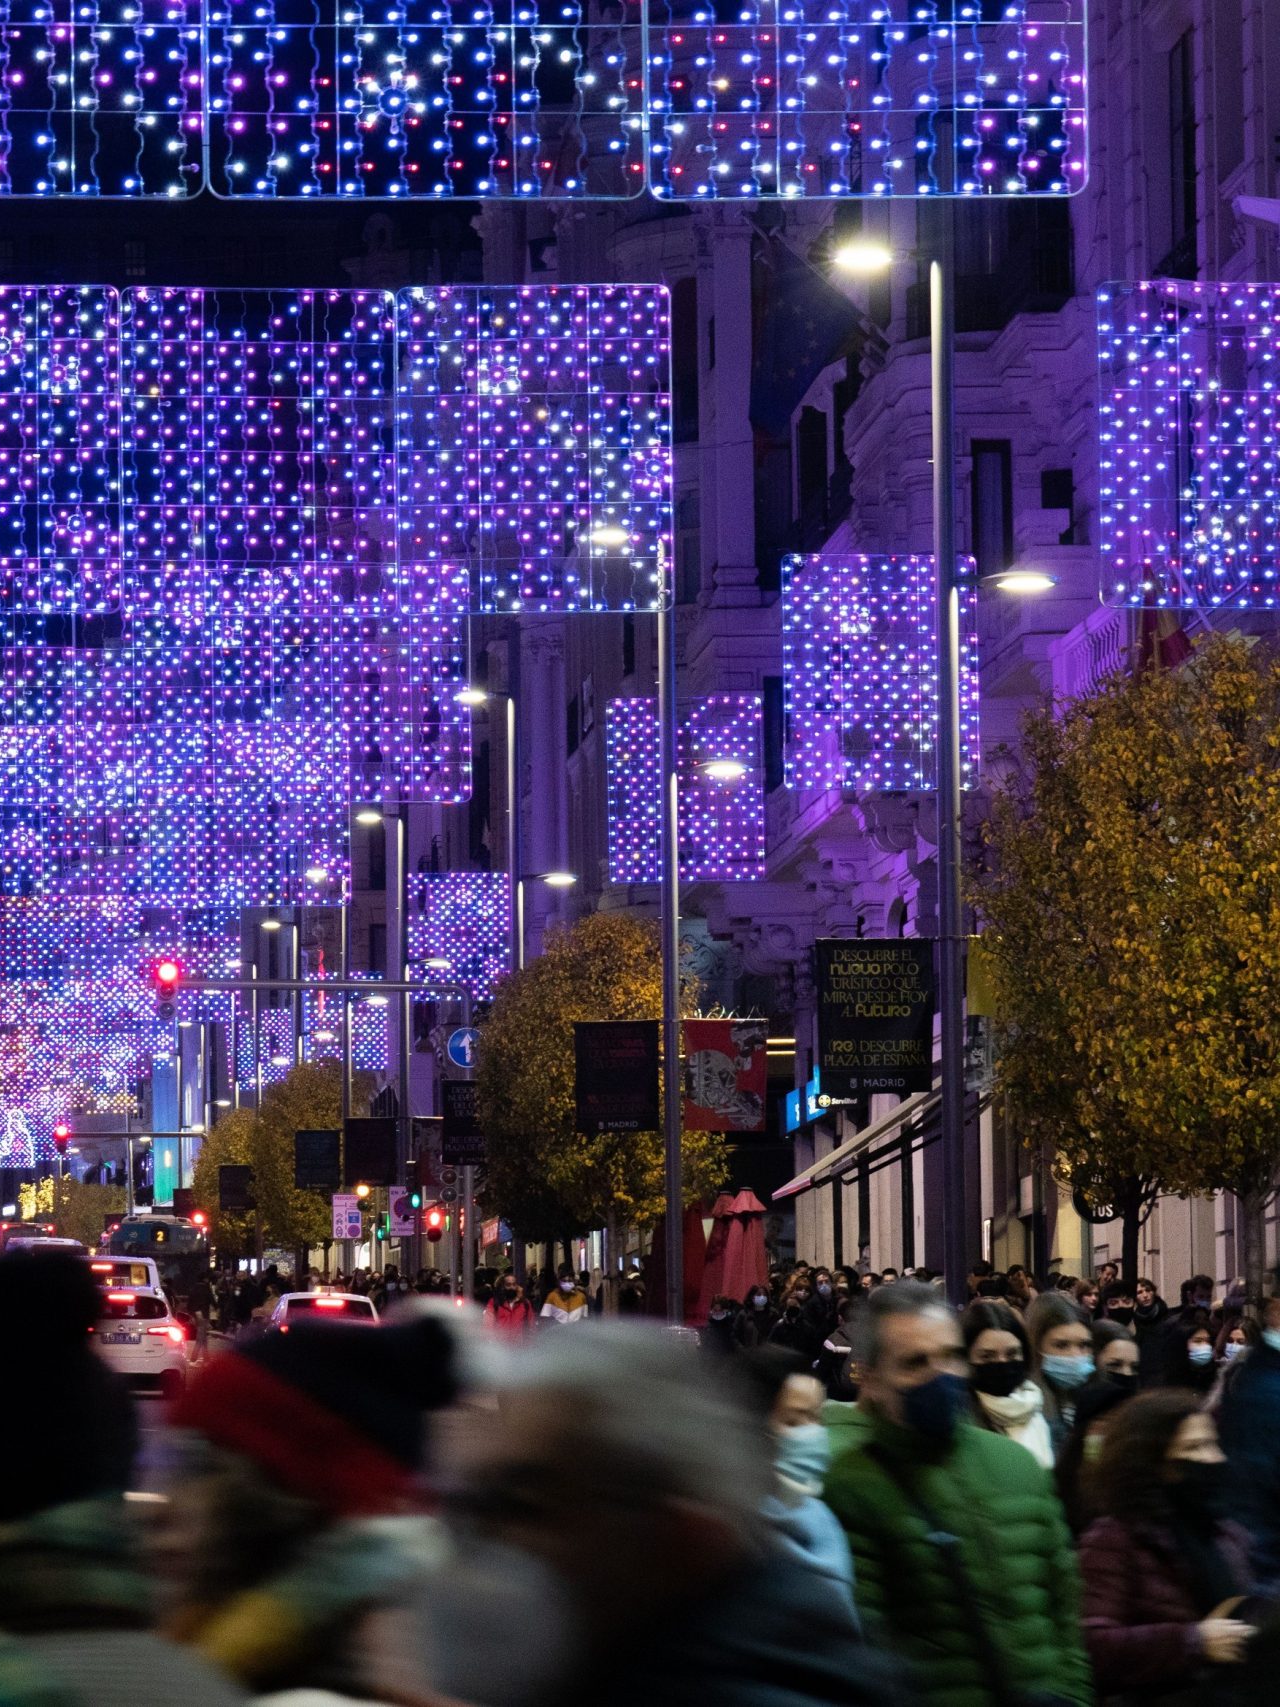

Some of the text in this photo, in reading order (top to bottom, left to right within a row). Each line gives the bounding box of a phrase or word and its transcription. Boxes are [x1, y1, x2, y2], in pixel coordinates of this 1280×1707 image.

[833, 949, 916, 961] DESCUBRE EL
[883, 963, 920, 976] POLO
[893, 977, 921, 992] QUE
[823, 990, 928, 1004] MIRA DESDE HOY
[841, 1006, 853, 1017] AL
[860, 1040, 924, 1053] DESCUBRE
[824, 1053, 927, 1067] PLAZA DE ESPAÑA
[863, 1078, 906, 1088] MADRID
[156, 1230, 164, 1241] 2
